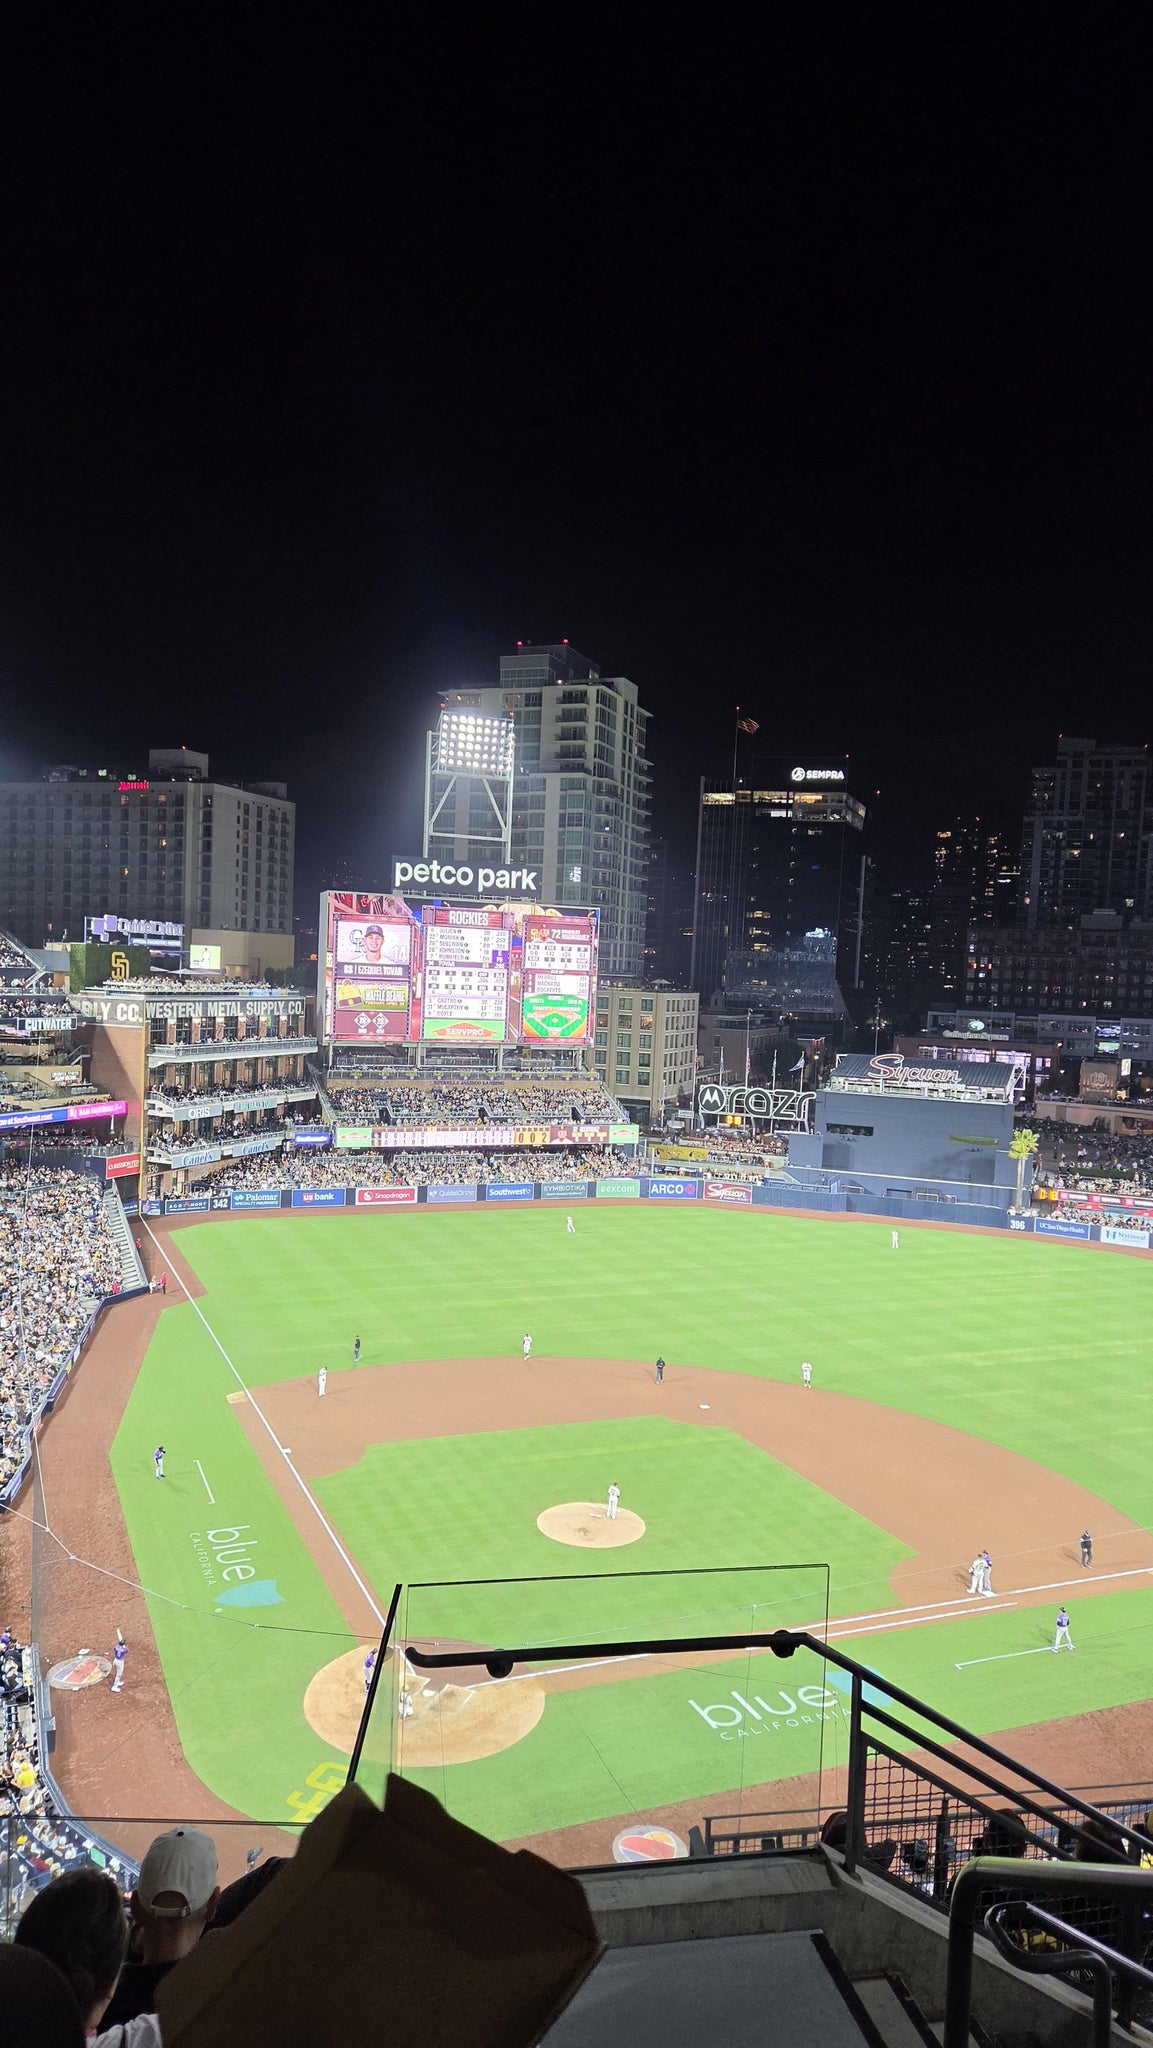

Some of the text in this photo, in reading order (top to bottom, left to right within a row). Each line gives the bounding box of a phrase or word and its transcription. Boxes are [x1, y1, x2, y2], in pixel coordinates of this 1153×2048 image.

[806, 770, 845, 779] SEMPRA
[118, 779, 149, 790] Marriott
[395, 860, 474, 887] petco
[477, 867, 538, 892] park
[449, 910, 489, 926] ROCKIES
[551, 929, 561, 938] 72
[383, 966, 403, 976] TOVAR
[116, 1002, 143, 1023] CO.
[145, 1000, 304, 1019] WESTERN METAL SUPPLY CO.
[25, 1018, 72, 1030] CUTWATER
[867, 1053, 962, 1085] Sycuan
[728, 1086, 817, 1120] razr
[188, 1107, 210, 1118] ORIS
[518, 1133, 524, 1143] 0
[530, 1133, 535, 1143] 0
[541, 1133, 547, 1143] 2
[243, 1142, 270, 1154] Canel's
[182, 1153, 213, 1165] Canel's
[147, 1163, 159, 1174] 336
[438, 1189, 475, 1197] QuidelOrtho
[489, 1187, 526, 1196] Southwest
[650, 1184, 684, 1195] ARCO
[707, 1183, 747, 1200] Sycuan
[245, 1193, 278, 1201] Palomar
[314, 1192, 335, 1201] bank
[374, 1191, 411, 1200] Snapdragon
[213, 1198, 228, 1209] 342
[1010, 1220, 1025, 1230] 396
[1070, 1226, 1085, 1234] Health
[1118, 1232, 1146, 1241] National
[206, 1525, 258, 1581] blue
[189, 1532, 216, 1586] CALIFORNIA
[687, 1685, 839, 1730] blue
[720, 1707, 852, 1741] CALIFORNIA
